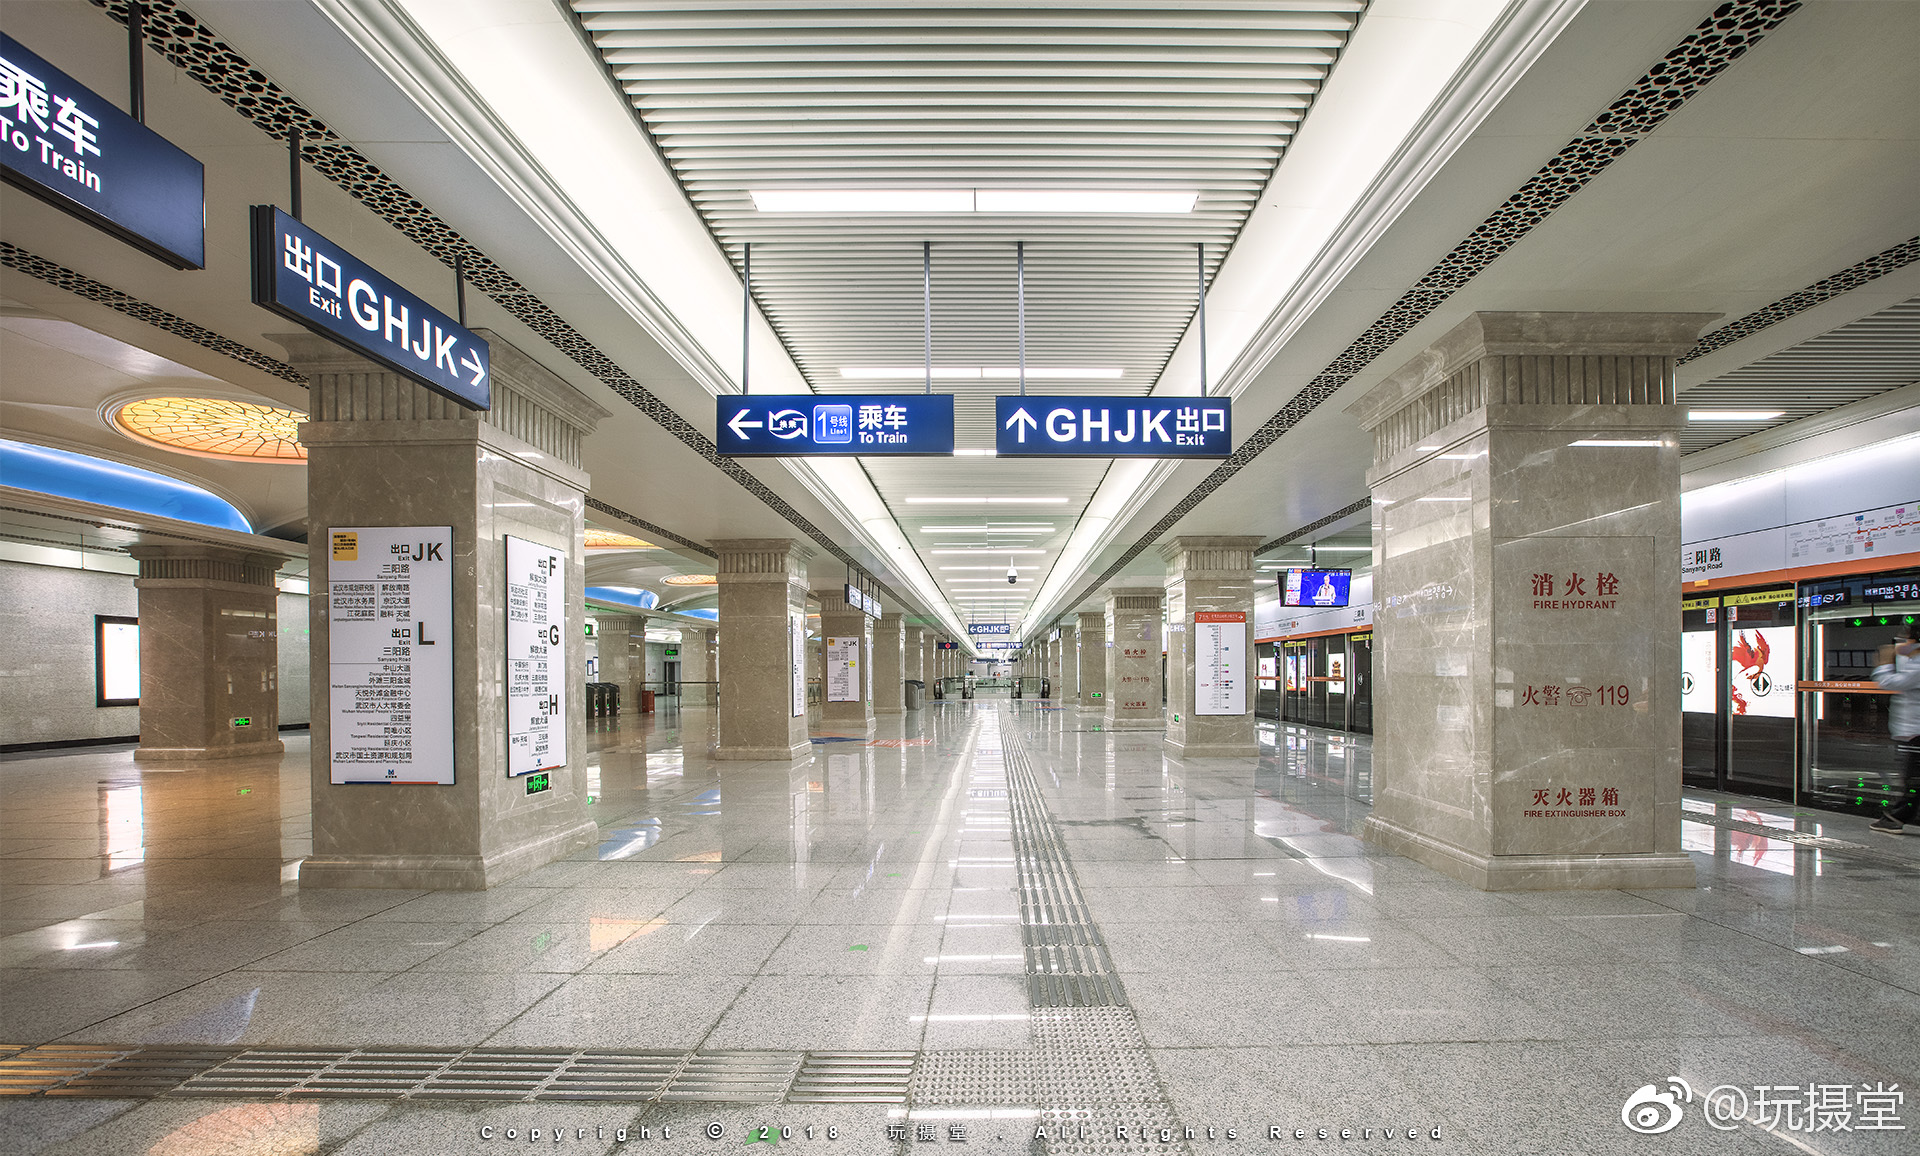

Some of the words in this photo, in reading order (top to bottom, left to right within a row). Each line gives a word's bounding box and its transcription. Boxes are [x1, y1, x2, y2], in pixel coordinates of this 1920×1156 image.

[0, 56, 101, 156] 乘车
[0, 114, 30, 152] To
[35, 135, 101, 193] Train
[285, 233, 342, 299] 出口
[309, 286, 342, 319] Exit
[347, 278, 459, 378] GHJK
[817, 411, 827, 437] 1
[830, 416, 848, 428] 号线
[858, 404, 908, 430] 乘车
[1045, 408, 1172, 443] GHJK
[1175, 406, 1225, 432] 出口
[858, 432, 874, 444] To
[877, 432, 908, 444] Train
[1175, 433, 1205, 446] Exit
[391, 544, 410, 554] 出口
[412, 543, 443, 561] JK
[1682, 547, 1721, 566] 三阳路
[382, 564, 410, 573] 三阳路
[549, 556, 557, 577] F
[1707, 562, 1723, 570] Road
[1531, 572, 1619, 597] 消火栓
[1533, 600, 1559, 609] FIRE
[1562, 600, 1616, 609] HYDRANT
[391, 628, 411, 638] 出口
[418, 621, 435, 645] L
[549, 624, 560, 646] G
[977, 625, 999, 633] GHJK
[383, 647, 411, 656] 三阳路
[549, 694, 558, 715] H
[1521, 685, 1560, 706] 火警
[1596, 685, 1629, 706] 119
[1531, 787, 1619, 807] 灭火器箱
[1524, 810, 1543, 818] FIRE
[1545, 810, 1606, 818] EXTINGUISHER
